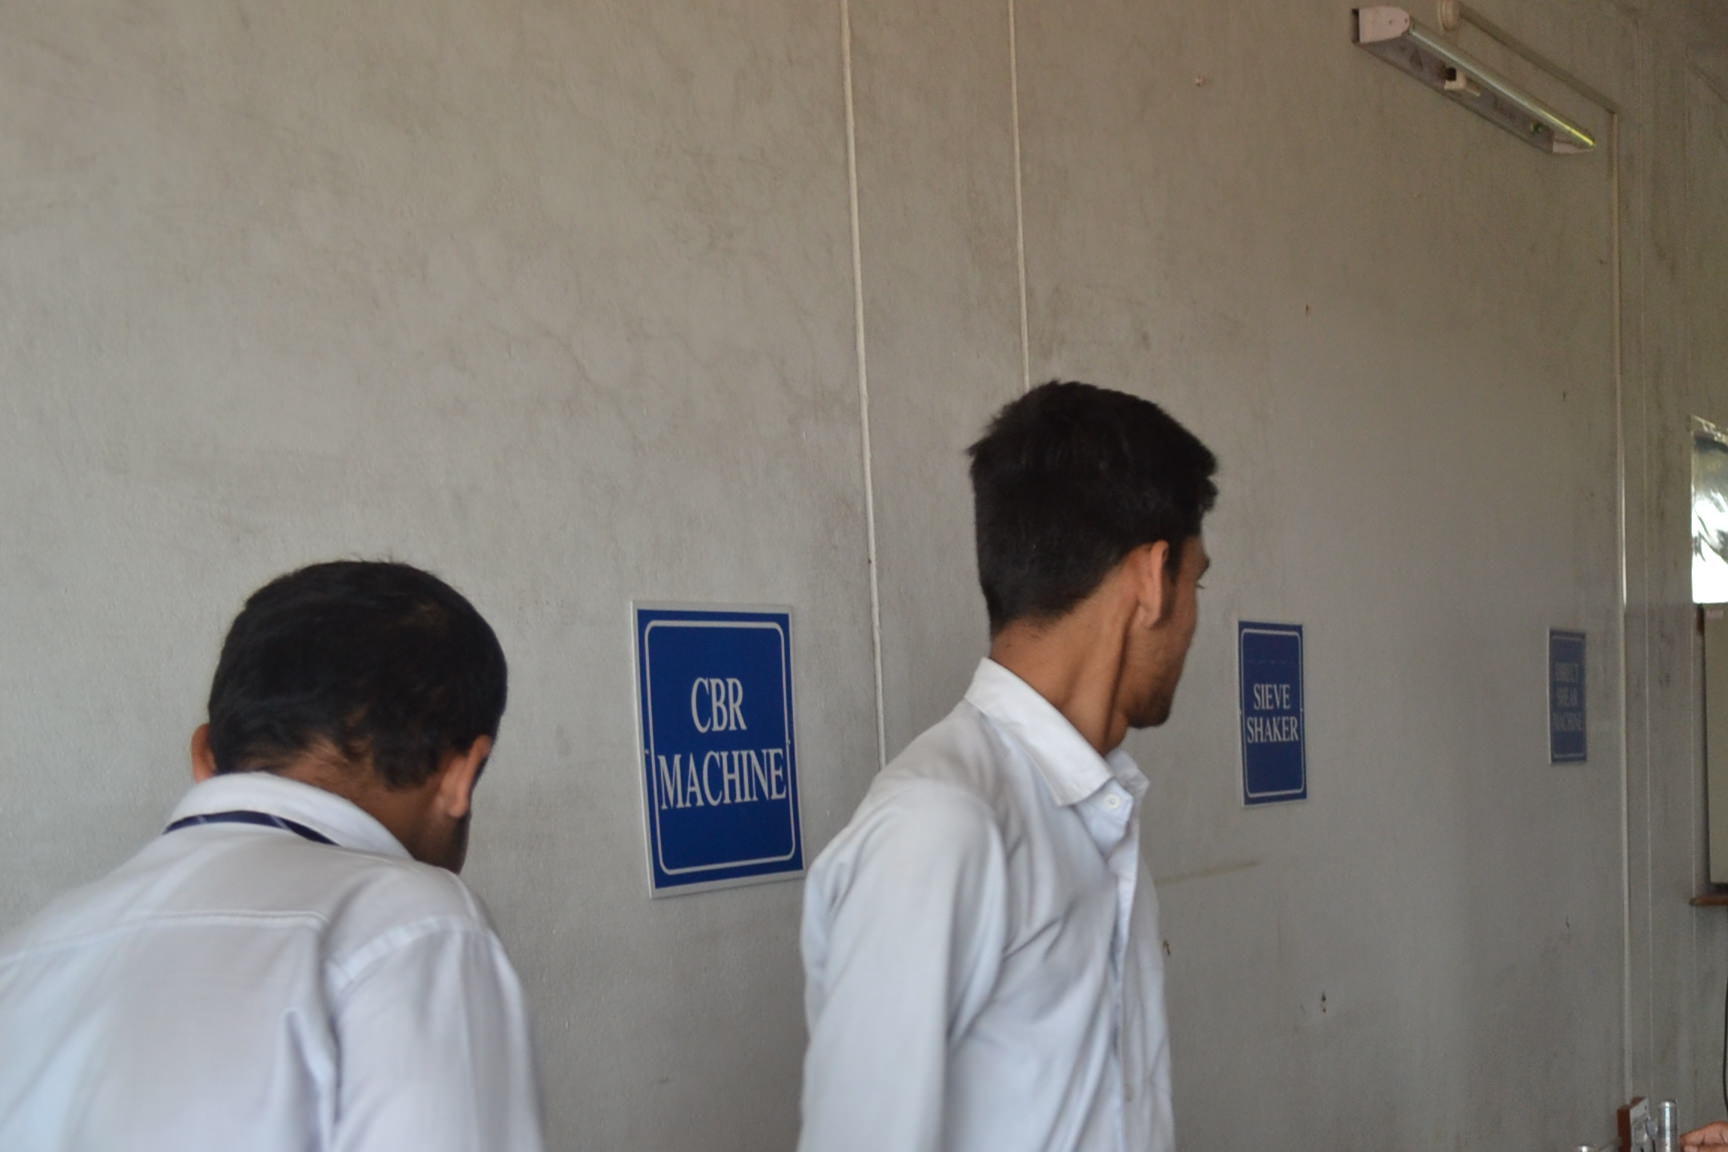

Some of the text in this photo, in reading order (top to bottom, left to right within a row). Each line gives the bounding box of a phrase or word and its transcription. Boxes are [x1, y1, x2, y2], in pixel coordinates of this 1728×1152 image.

[691, 676, 747, 733] CBR
[1253, 683, 1292, 710] SIEVE
[1247, 716, 1299, 743] SHAKER
[657, 748, 787, 810] MACHINE
